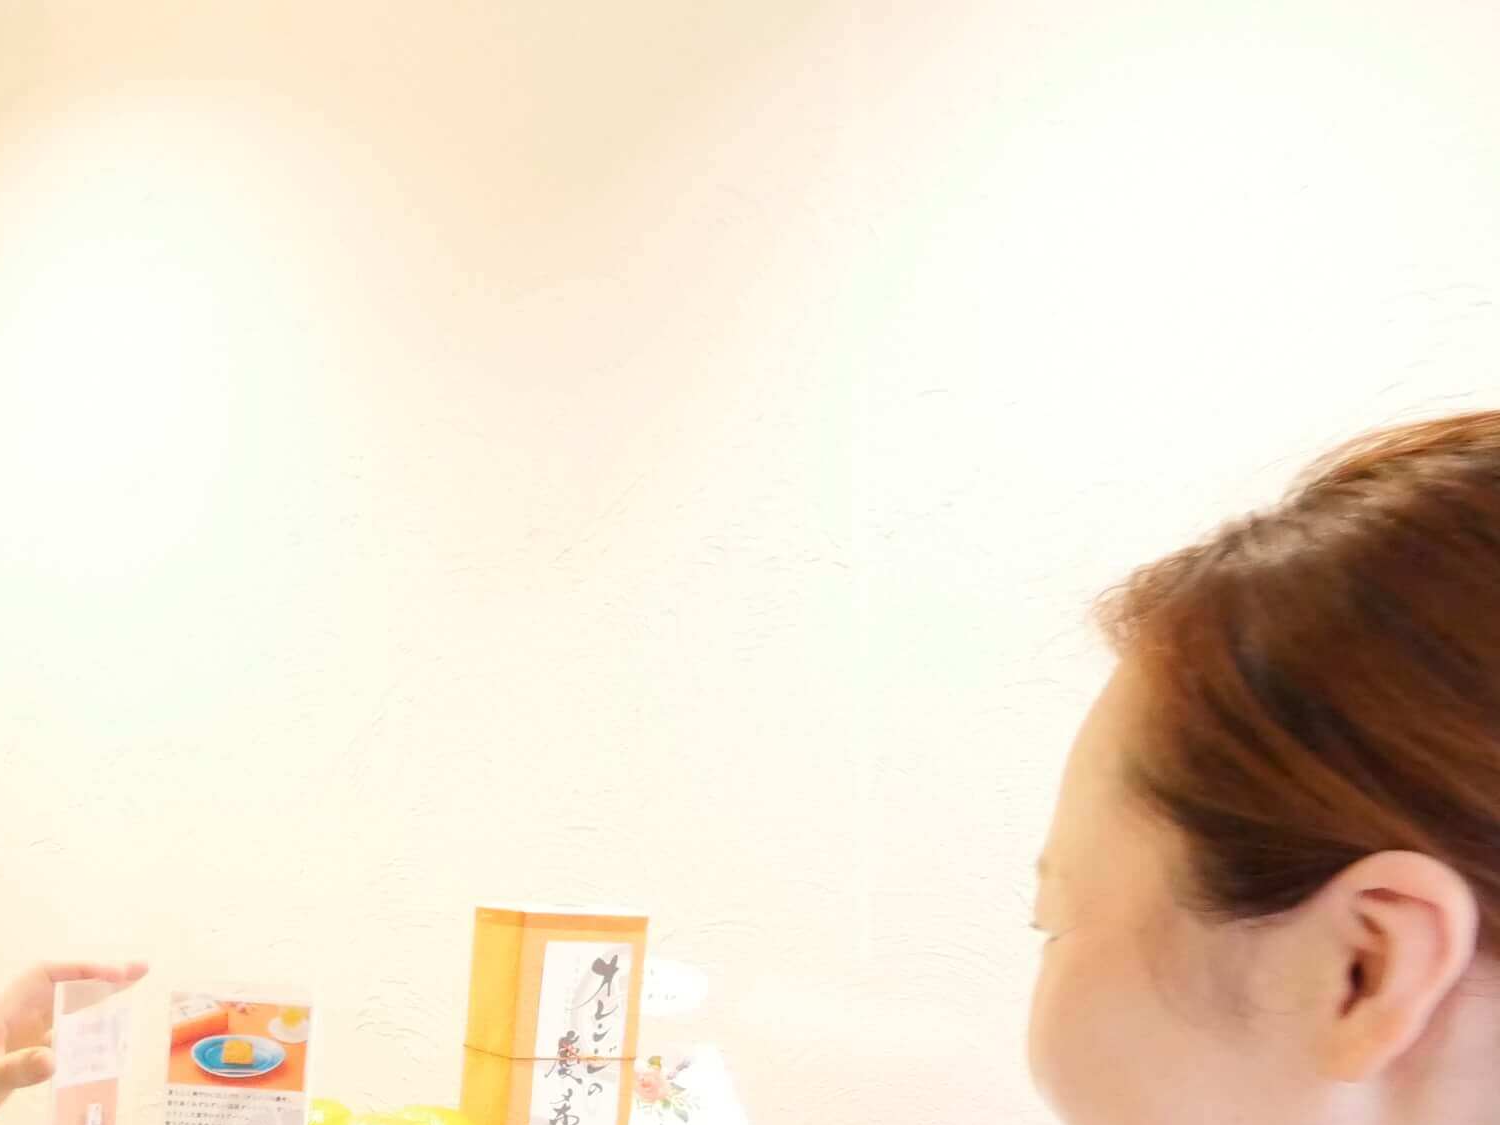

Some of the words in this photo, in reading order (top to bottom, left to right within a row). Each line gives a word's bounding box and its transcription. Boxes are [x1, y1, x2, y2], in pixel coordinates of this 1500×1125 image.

[572, 954, 620, 1096] オレンジの
